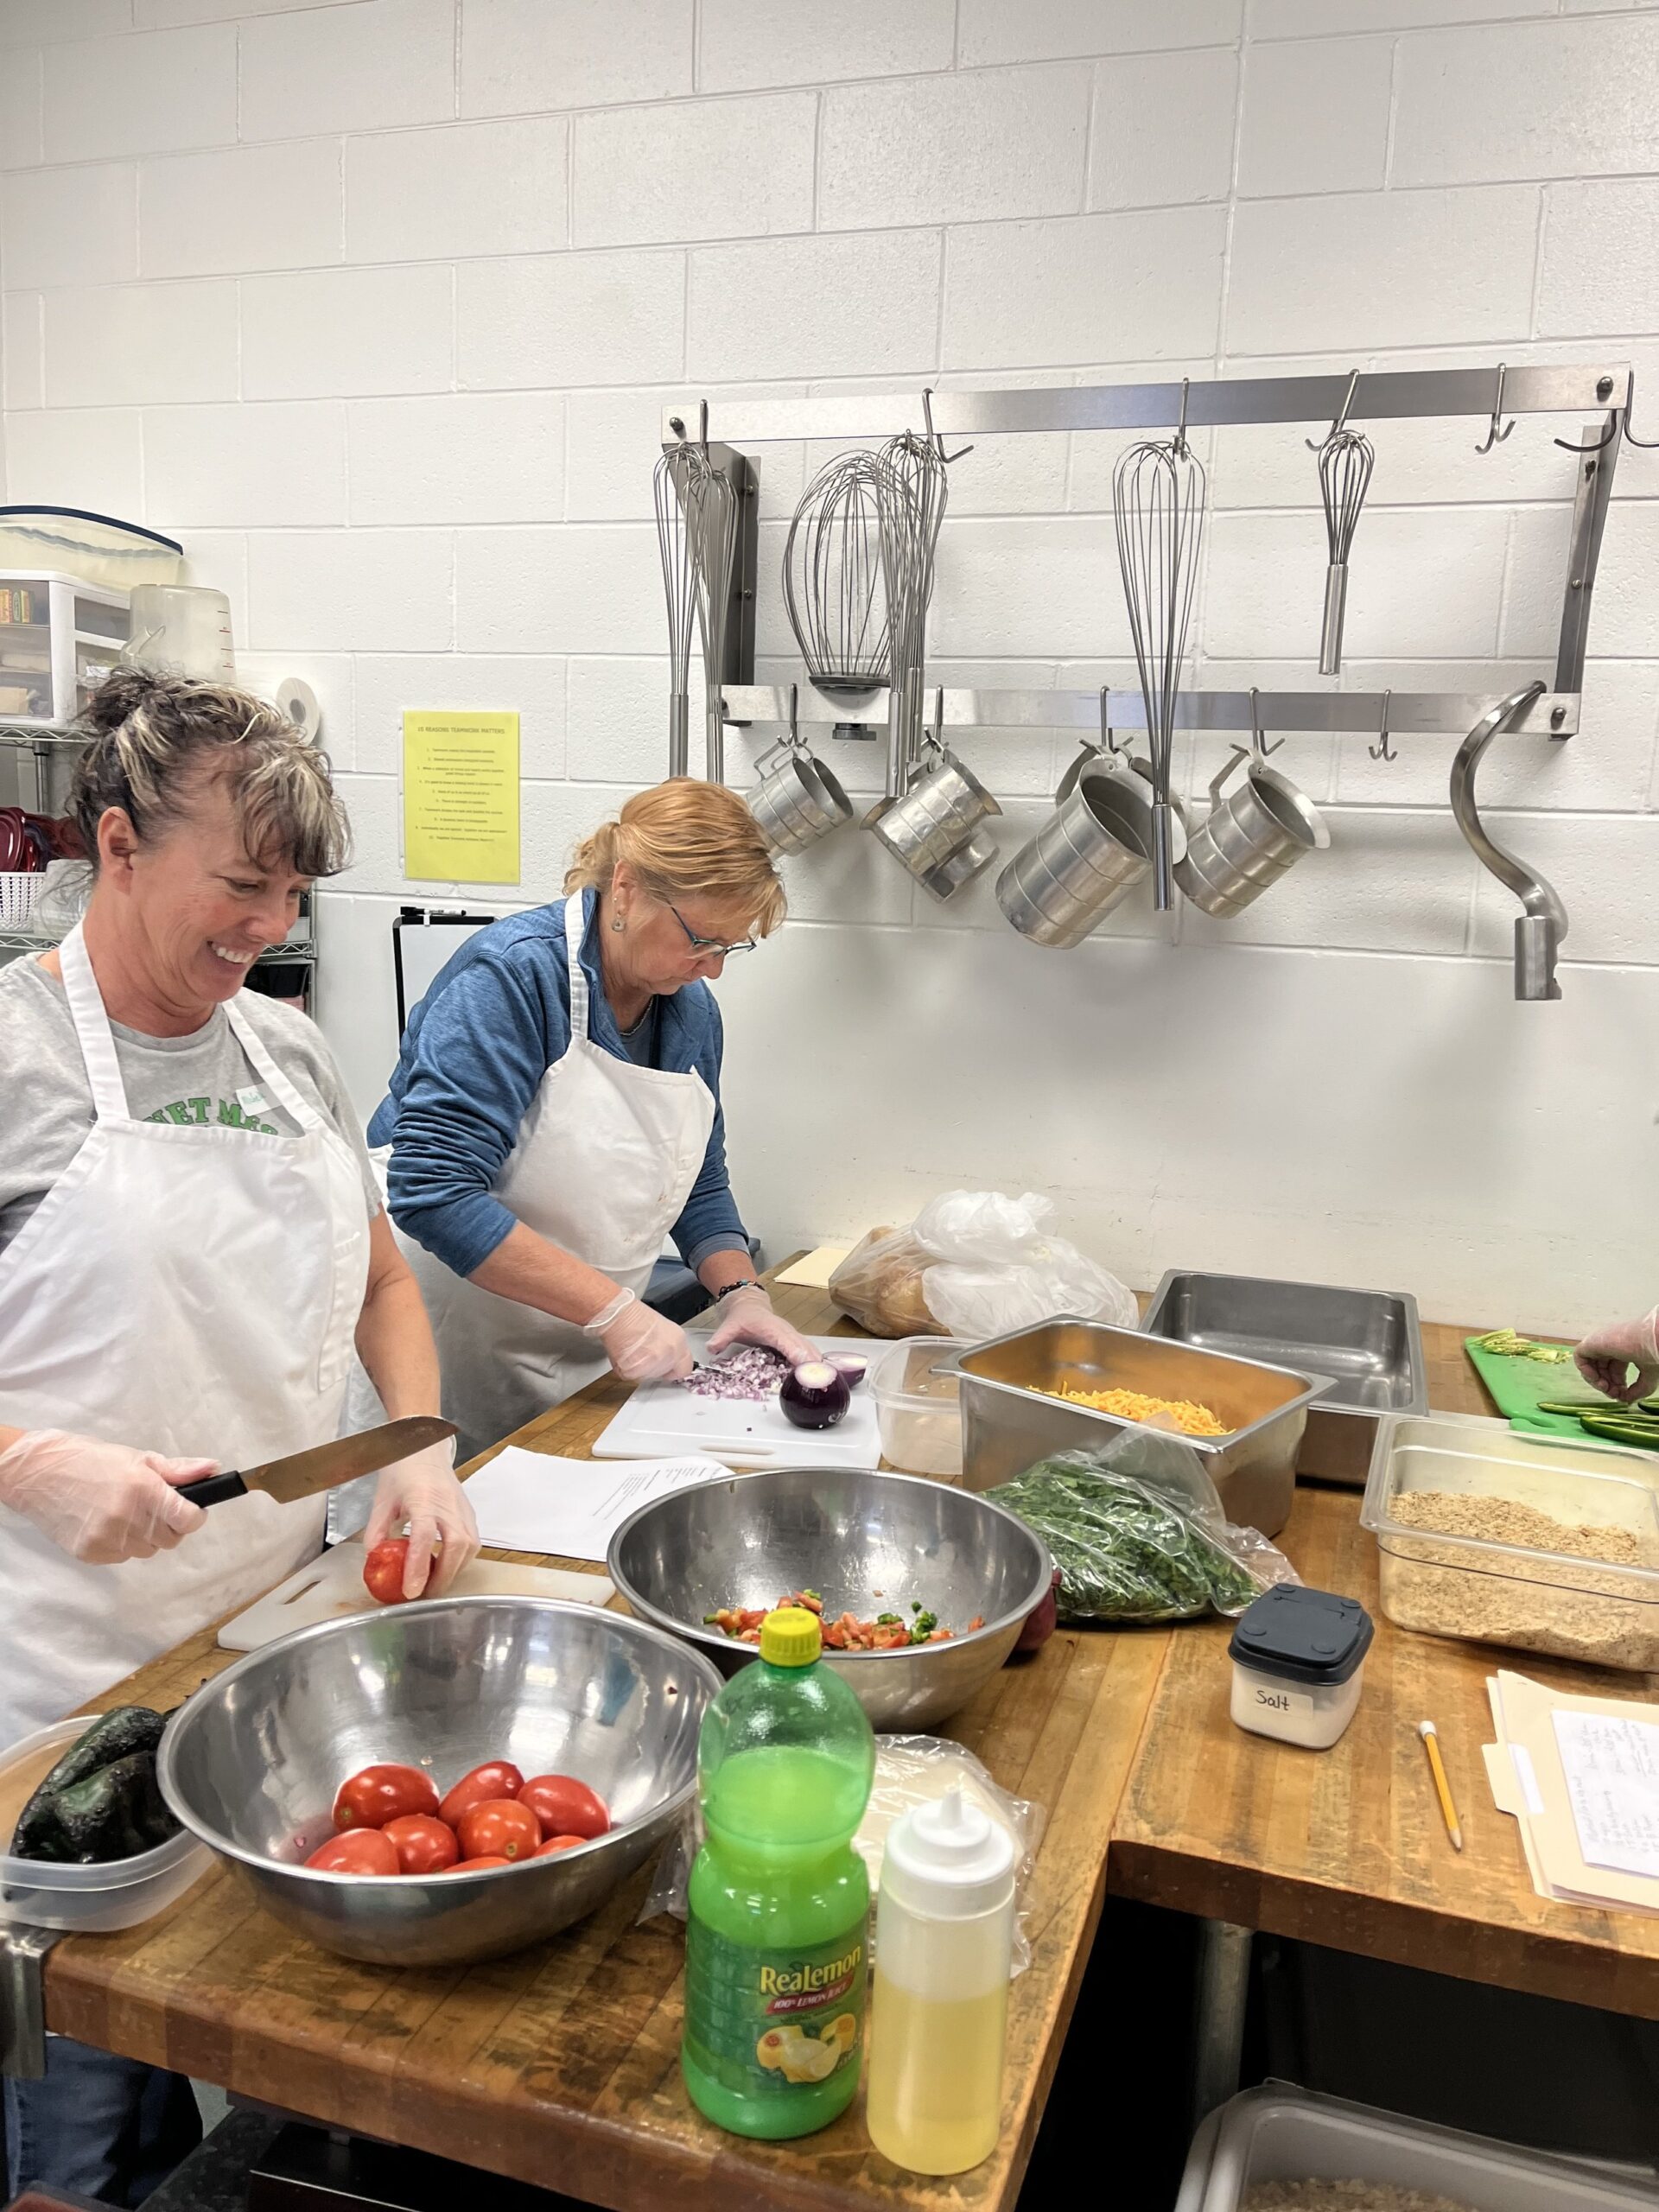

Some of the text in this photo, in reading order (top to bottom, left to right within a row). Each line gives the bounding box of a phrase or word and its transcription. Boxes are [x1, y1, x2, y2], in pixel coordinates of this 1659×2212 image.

[1255, 1690, 1290, 1711] Salt
[760, 1945, 861, 1996] ReaLemon
[796, 1993, 825, 2007] LEMON
